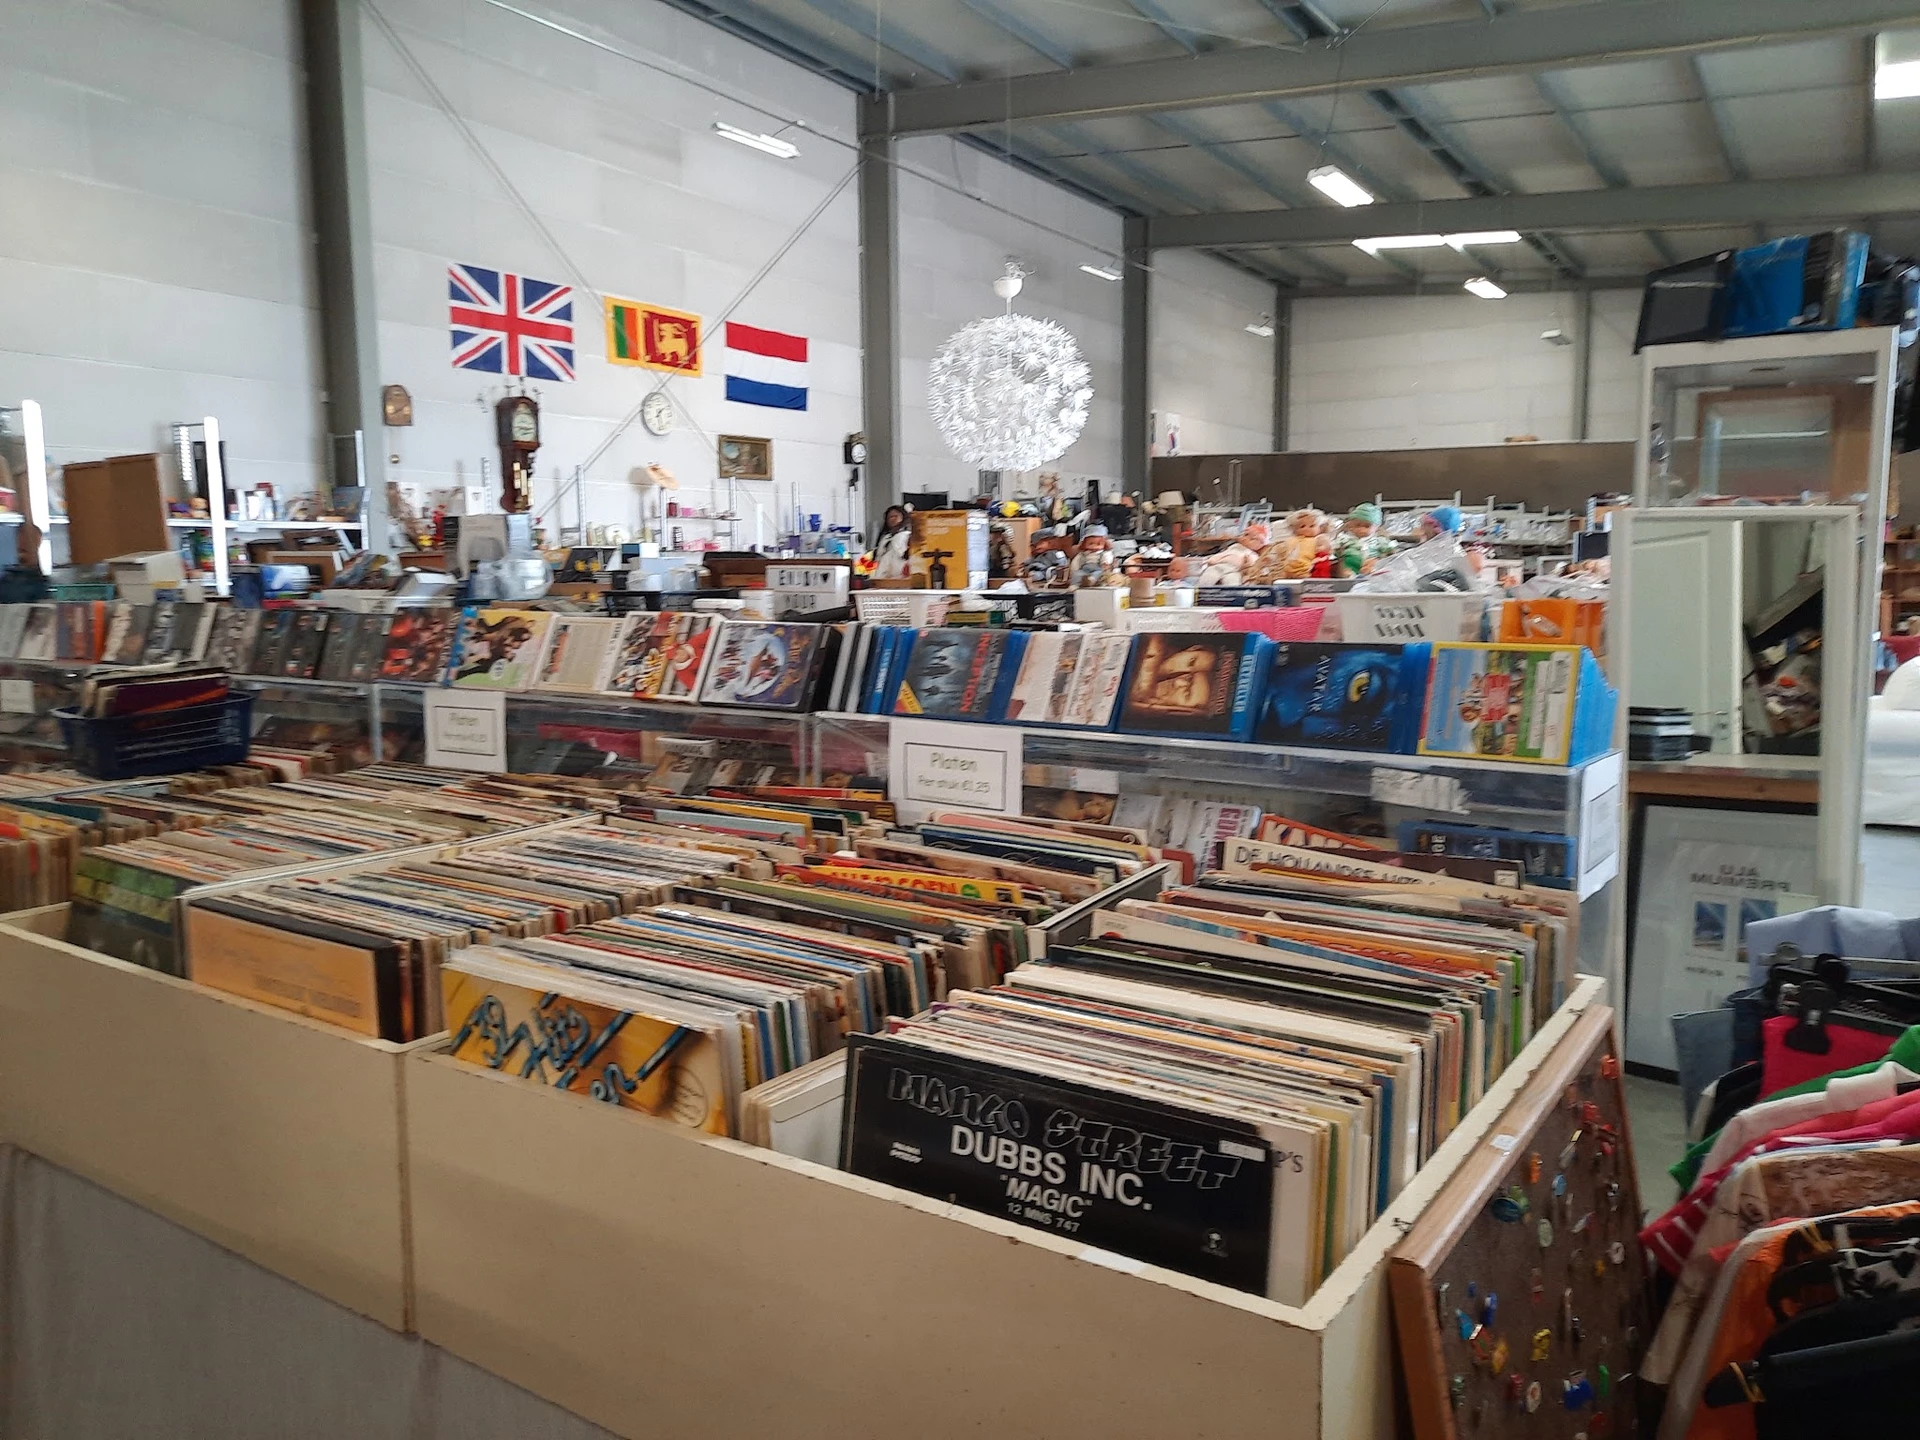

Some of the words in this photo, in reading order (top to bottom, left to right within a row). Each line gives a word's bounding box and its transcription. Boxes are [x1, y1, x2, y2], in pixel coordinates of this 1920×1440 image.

[1306, 654, 1333, 714] AVATAR
[930, 752, 978, 773] Platen
[951, 1124, 1067, 1185] DUBBS
[1080, 1161, 1153, 1211] INC.
[1042, 1108, 1243, 1189] STREET
[1007, 1202, 1022, 1216] 12
[1055, 1217, 1081, 1233] 747
